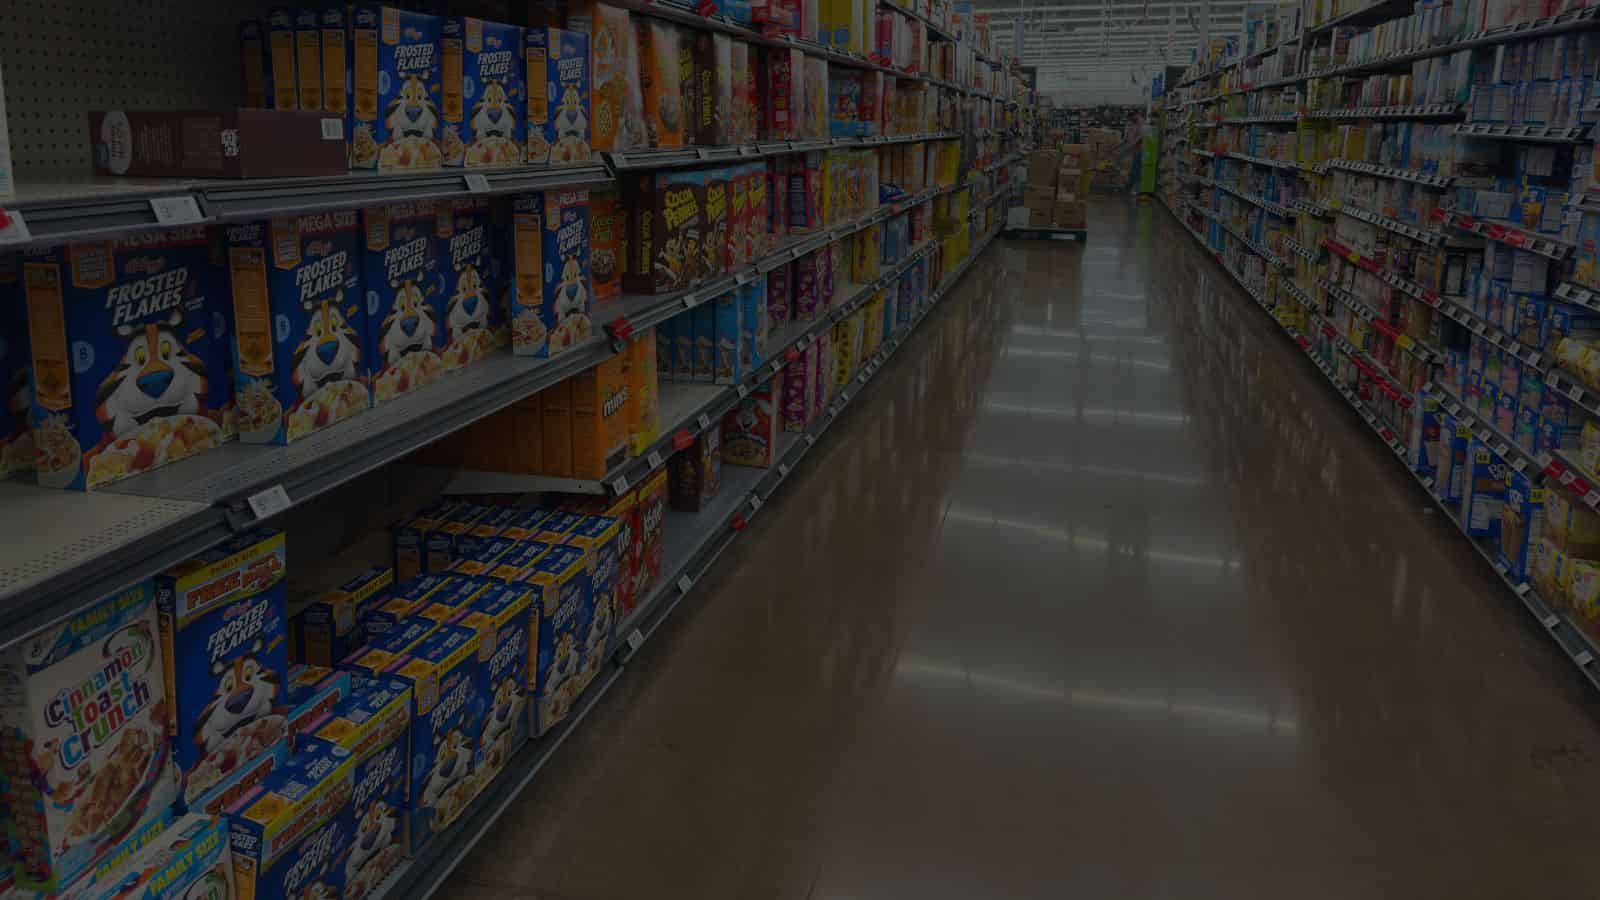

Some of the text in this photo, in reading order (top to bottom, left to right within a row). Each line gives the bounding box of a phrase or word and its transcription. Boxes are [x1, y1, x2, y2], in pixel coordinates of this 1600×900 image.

[394, 43, 434, 59] FROSTED
[397, 55, 432, 71] FLAKES
[477, 50, 513, 65] FROSTED
[557, 57, 584, 71] FROSTED
[479, 61, 510, 76] FLAKES
[559, 67, 582, 81] FLAKES
[298, 213, 333, 233] MEGA
[557, 219, 584, 244] FROSTED
[384, 237, 427, 267] FROSTED
[450, 225, 484, 255] FROSTED
[559, 232, 582, 256] FLAKES
[296, 251, 348, 286] FROSTED
[387, 255, 424, 282] FLAKES
[453, 243, 481, 268] FLAKES
[105, 266, 188, 310] FROSTED
[300, 270, 345, 302] FLAKES
[112, 287, 182, 327] FLAKES
[207, 599, 269, 652] FROSTED
[211, 618, 265, 664] FLAKES
[430, 674, 471, 725] FROSTED
[353, 746, 397, 804] FROSTED
[149, 831, 220, 897] FAMILY SIZE
